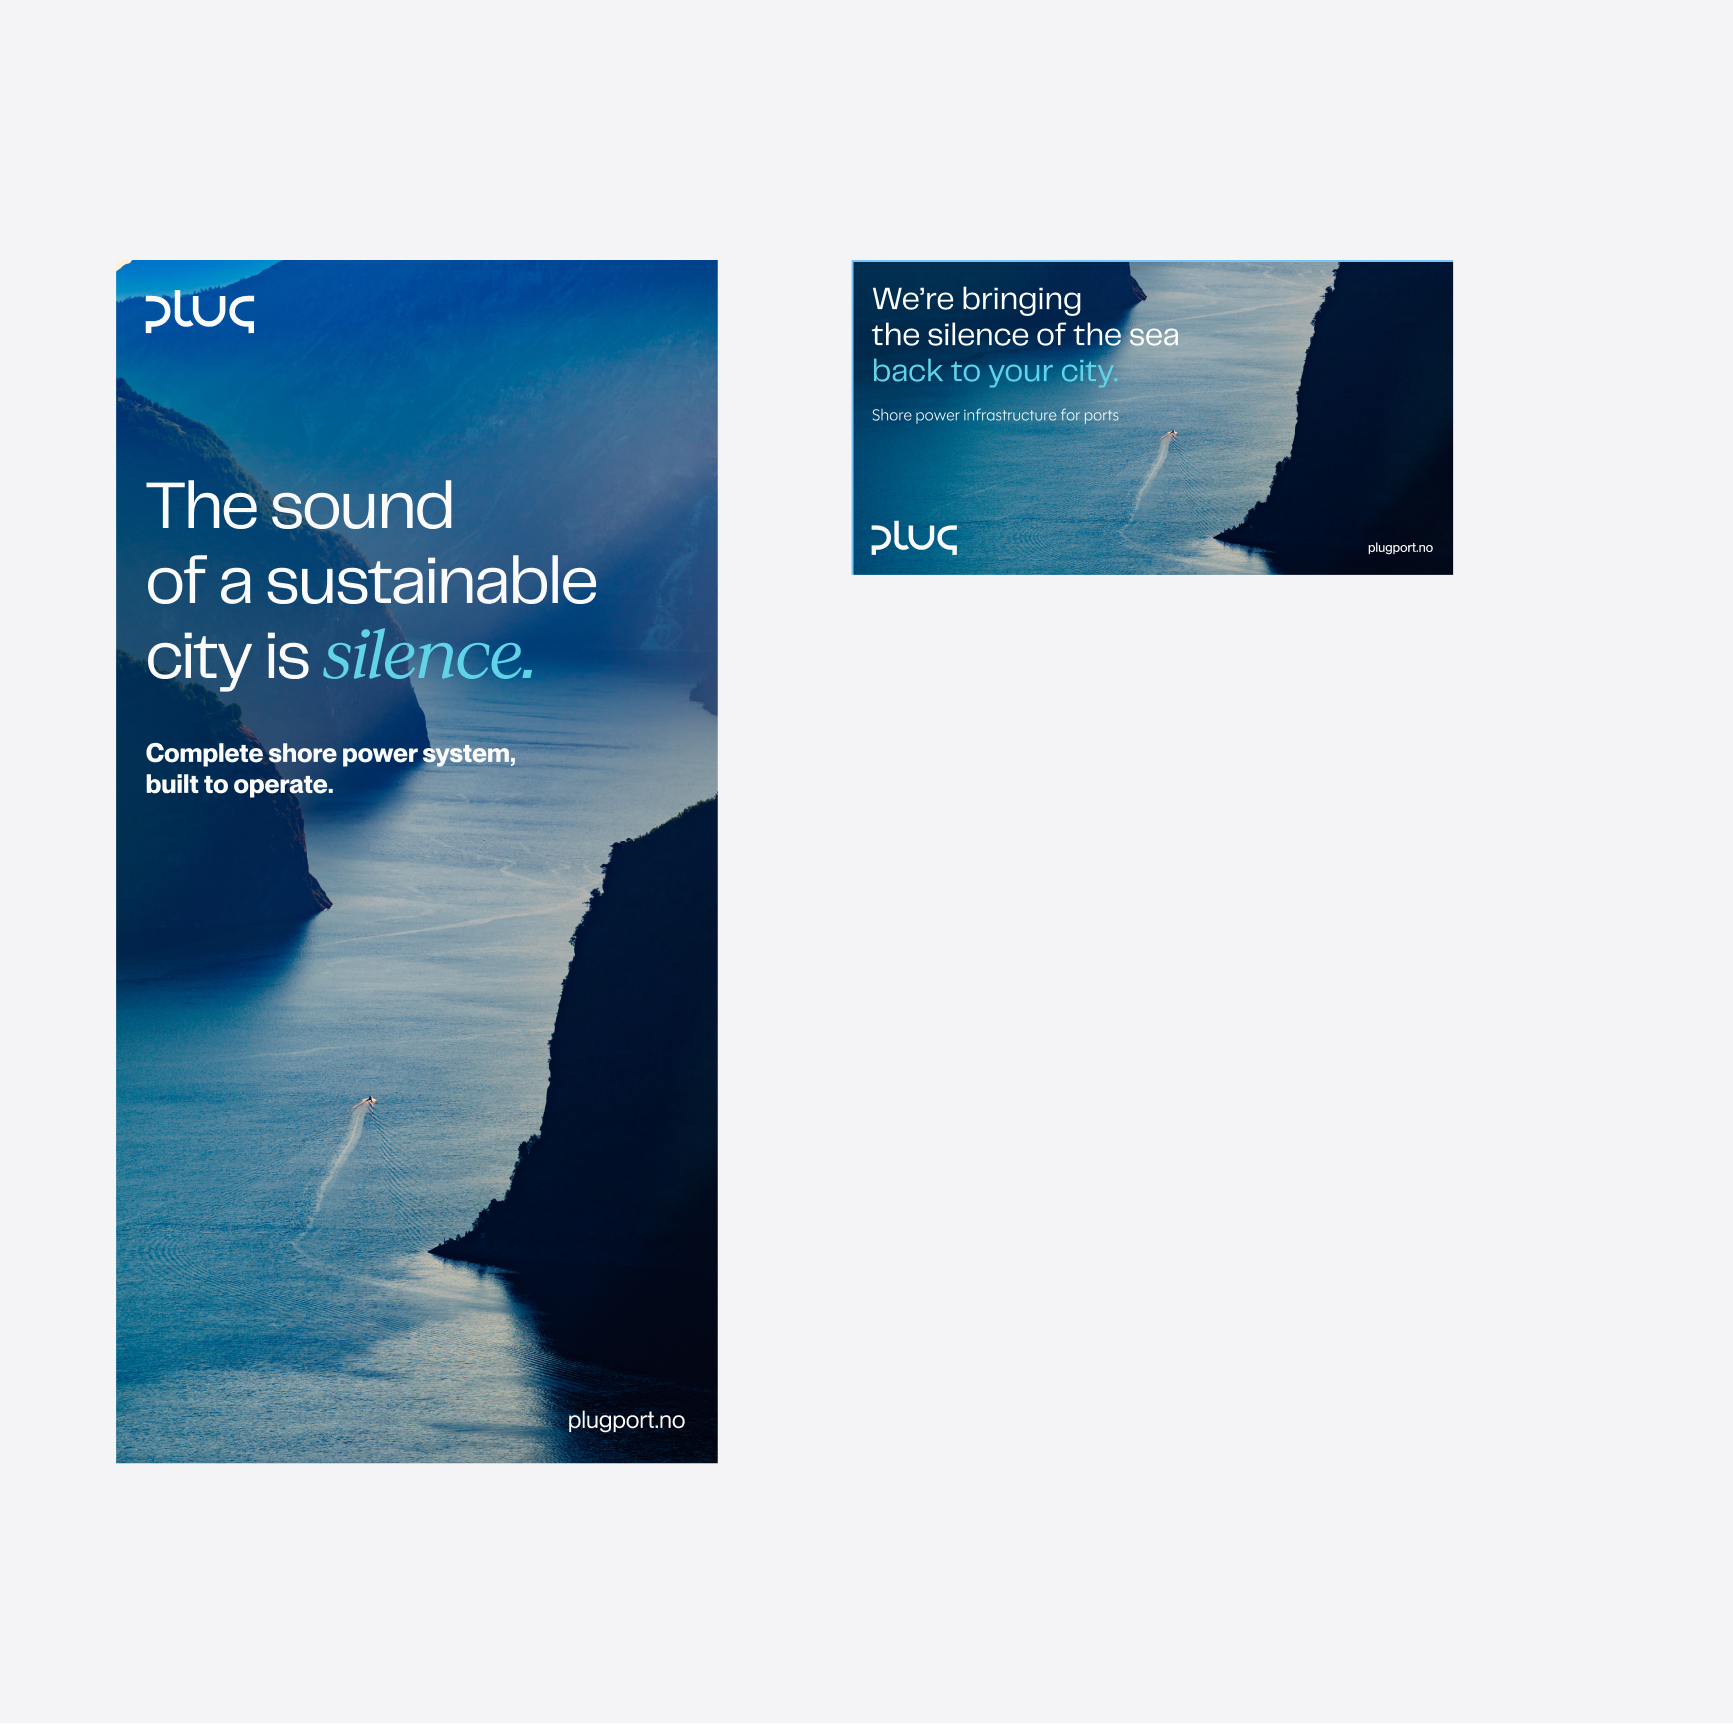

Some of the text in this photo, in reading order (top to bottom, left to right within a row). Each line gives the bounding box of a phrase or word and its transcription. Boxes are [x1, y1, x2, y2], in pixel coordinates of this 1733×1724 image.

[963, 286, 1081, 317] bringing
[871, 322, 1179, 347] the silence of the sea
[873, 358, 1119, 389] back to your city.
[872, 408, 1119, 425] Shore power infrastructure for ports
[146, 479, 452, 530] The sound
[1368, 542, 1434, 557] plugport.no
[147, 554, 597, 605] of a sustainable
[147, 628, 533, 692] city is silence.
[146, 742, 516, 768] Complete shore power system,
[146, 773, 334, 798] built to operate.
[568, 1410, 685, 1433] plugport.no
